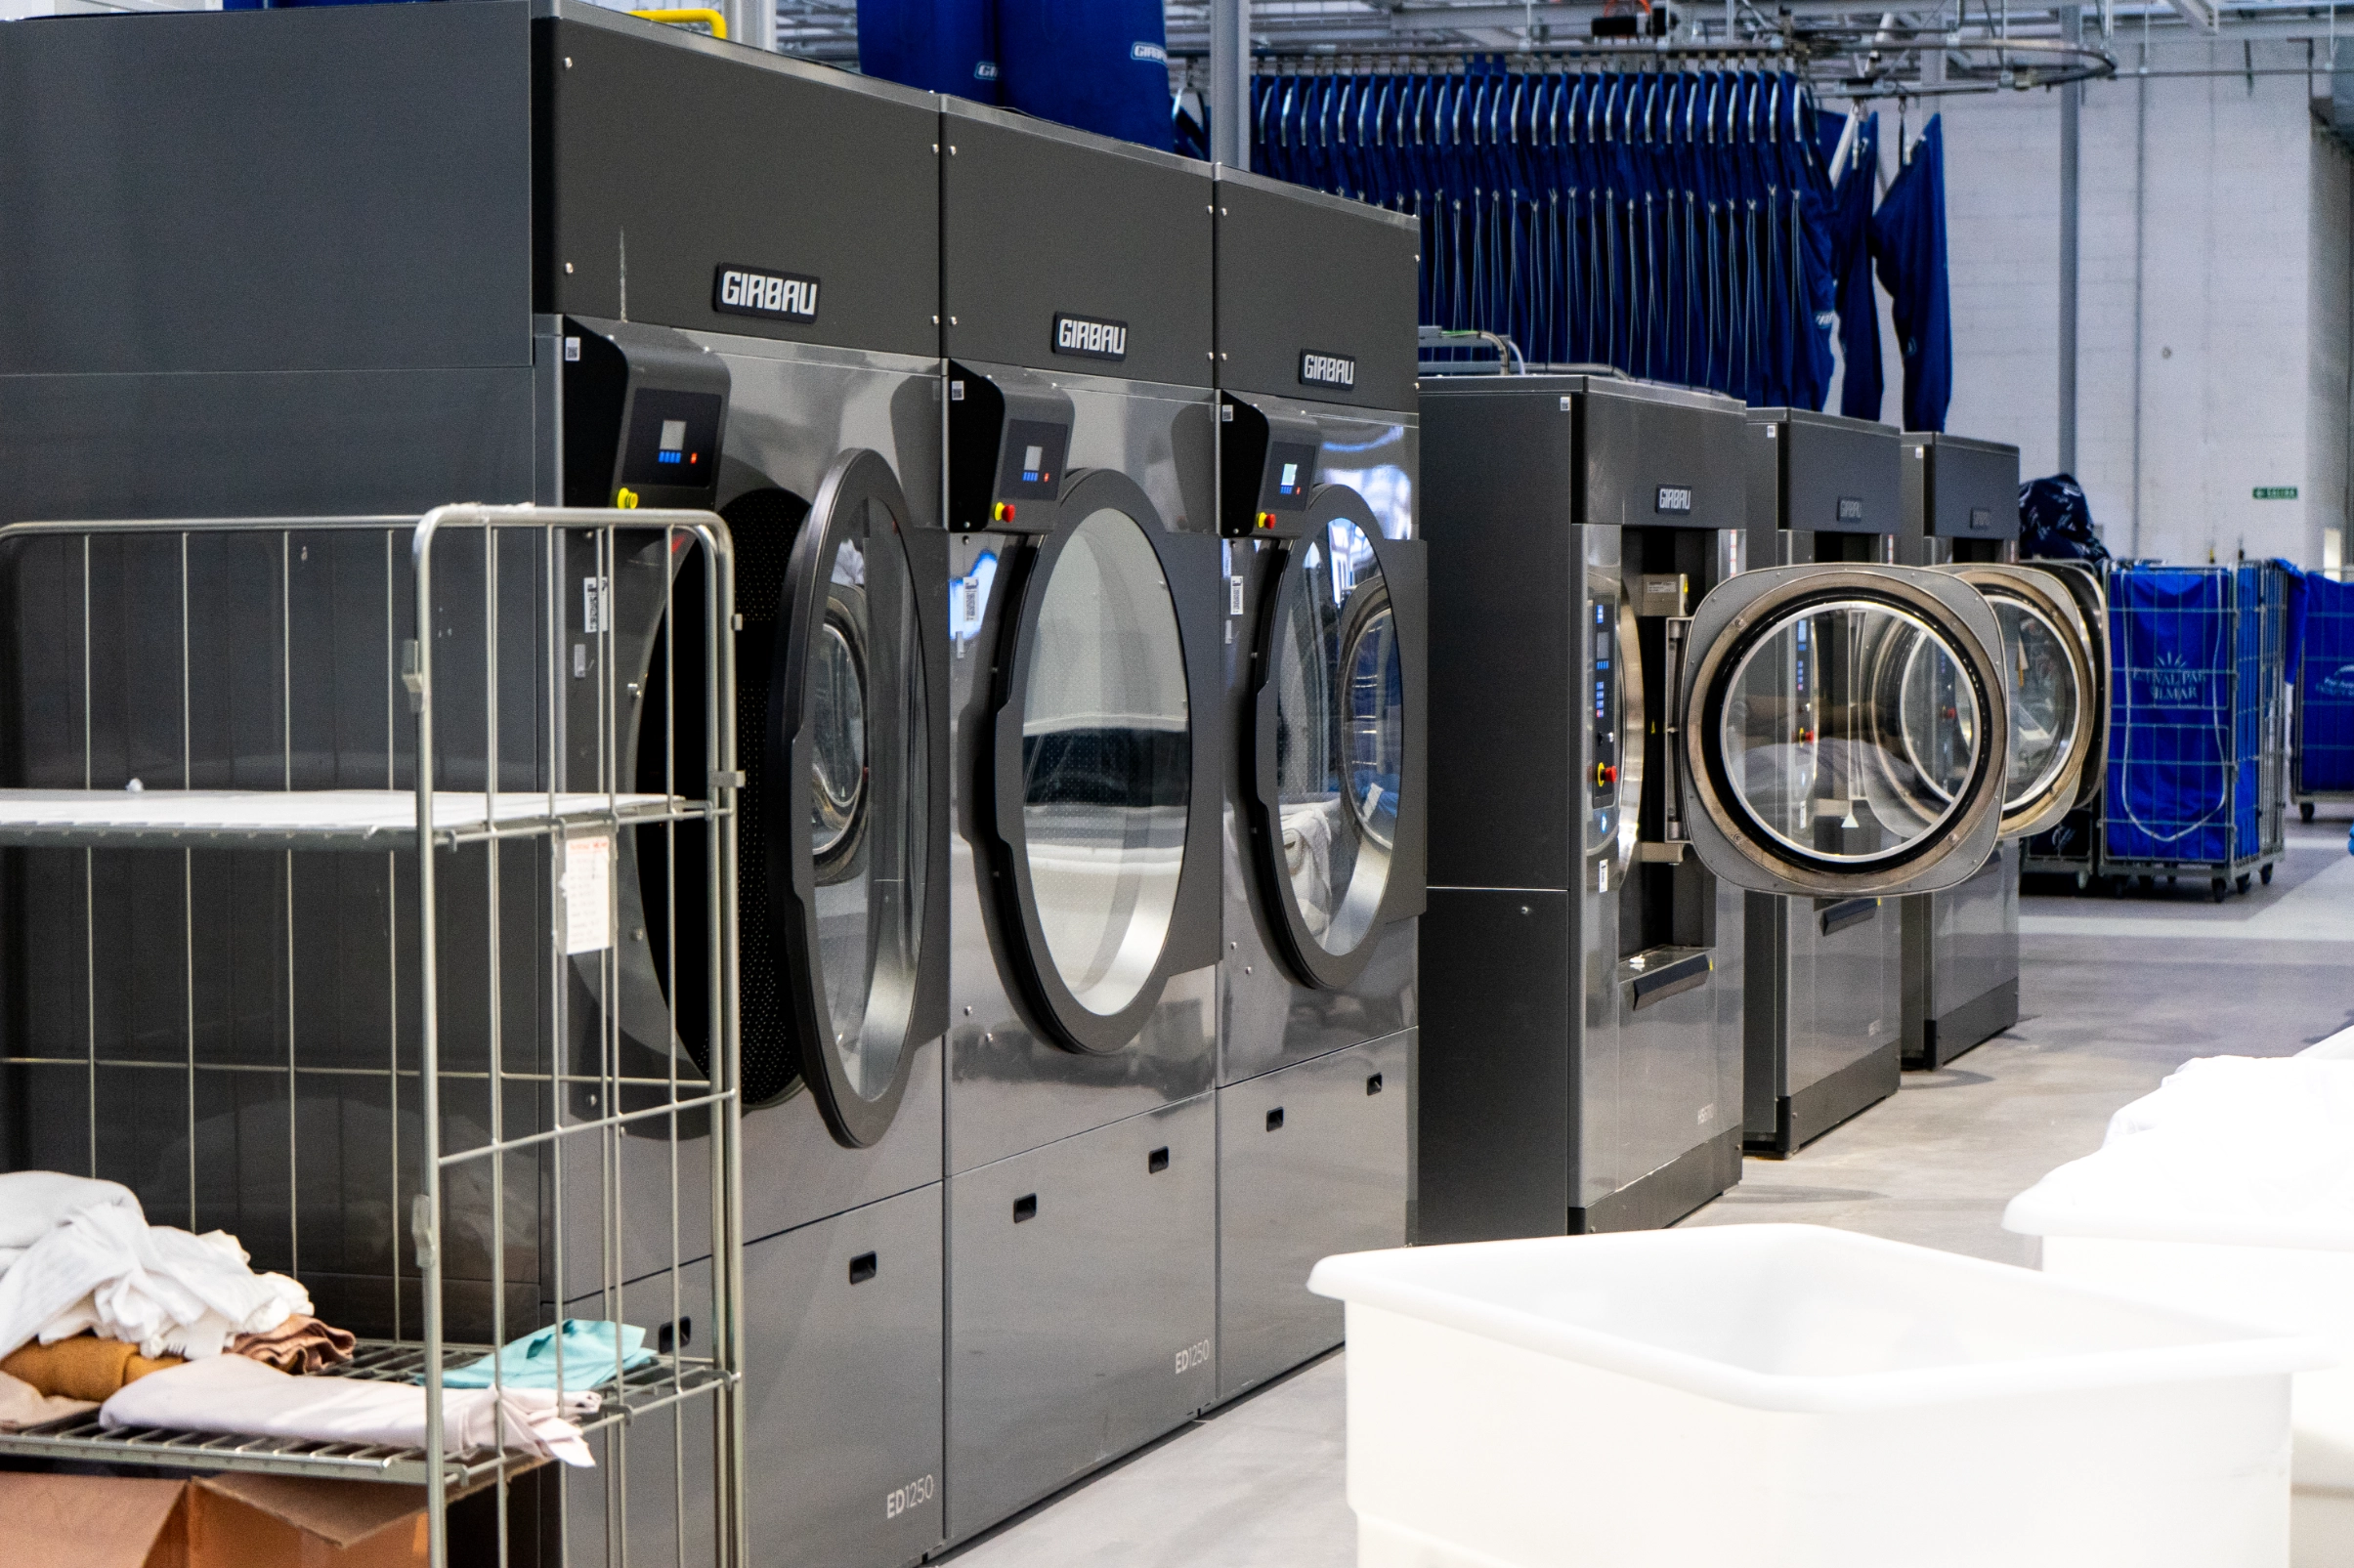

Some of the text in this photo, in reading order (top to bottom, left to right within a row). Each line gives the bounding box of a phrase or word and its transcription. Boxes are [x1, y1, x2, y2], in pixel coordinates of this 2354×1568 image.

[721, 270, 818, 316] GIRBAU
[1058, 318, 1127, 355] GIRBAU
[1304, 354, 1355, 385] GIRBAU
[1659, 487, 1691, 510] GIRBAU
[1175, 1338, 1211, 1375] ED1250
[885, 1473, 935, 1520] ED1250
